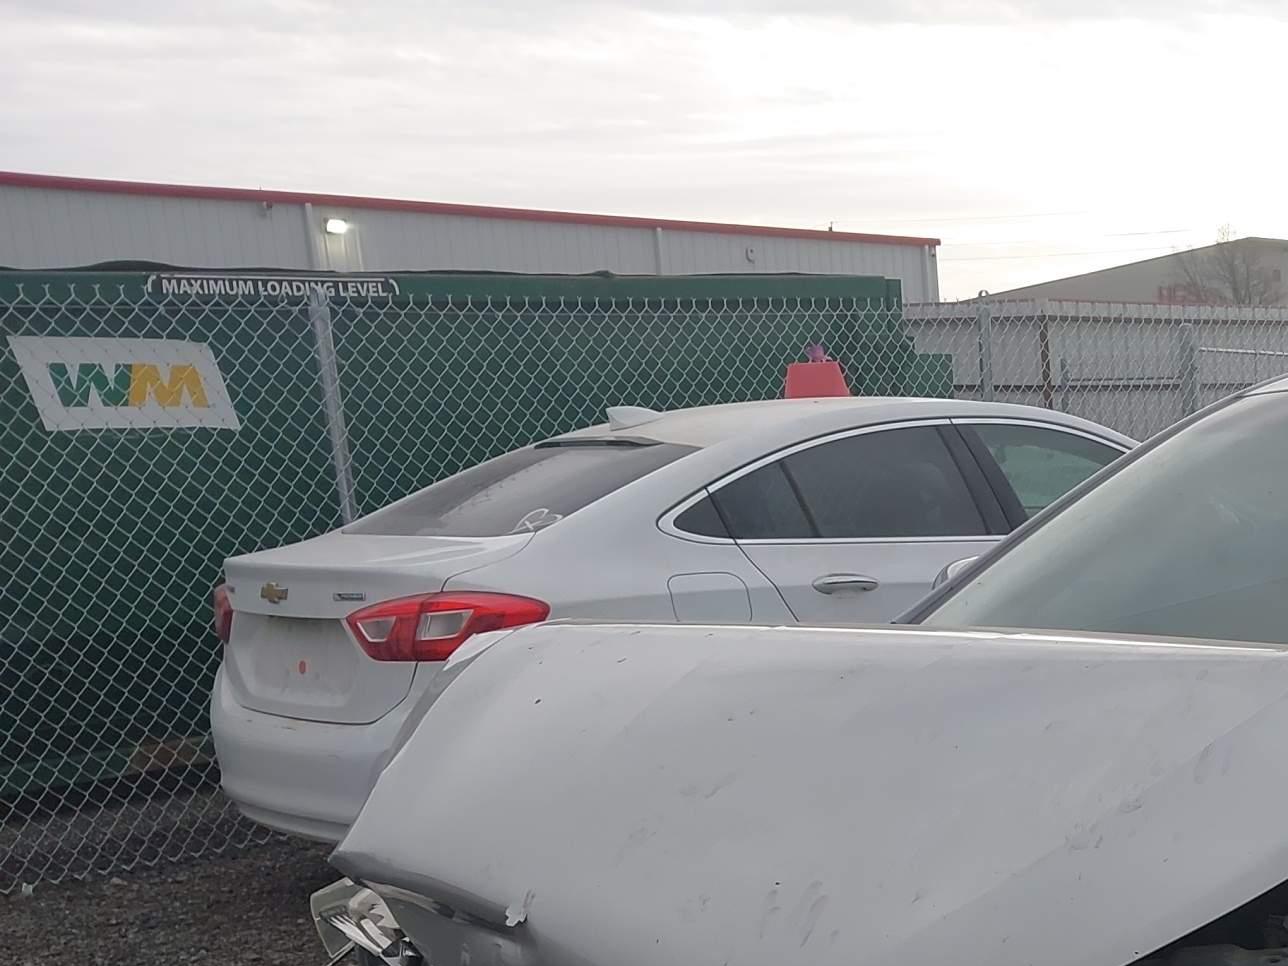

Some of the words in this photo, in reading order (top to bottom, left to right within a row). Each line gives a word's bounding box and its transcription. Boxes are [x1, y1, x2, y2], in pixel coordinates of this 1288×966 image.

[161, 278, 254, 296] MAXIMUM
[339, 282, 388, 297] LEVEL
[48, 362, 210, 408] WM
